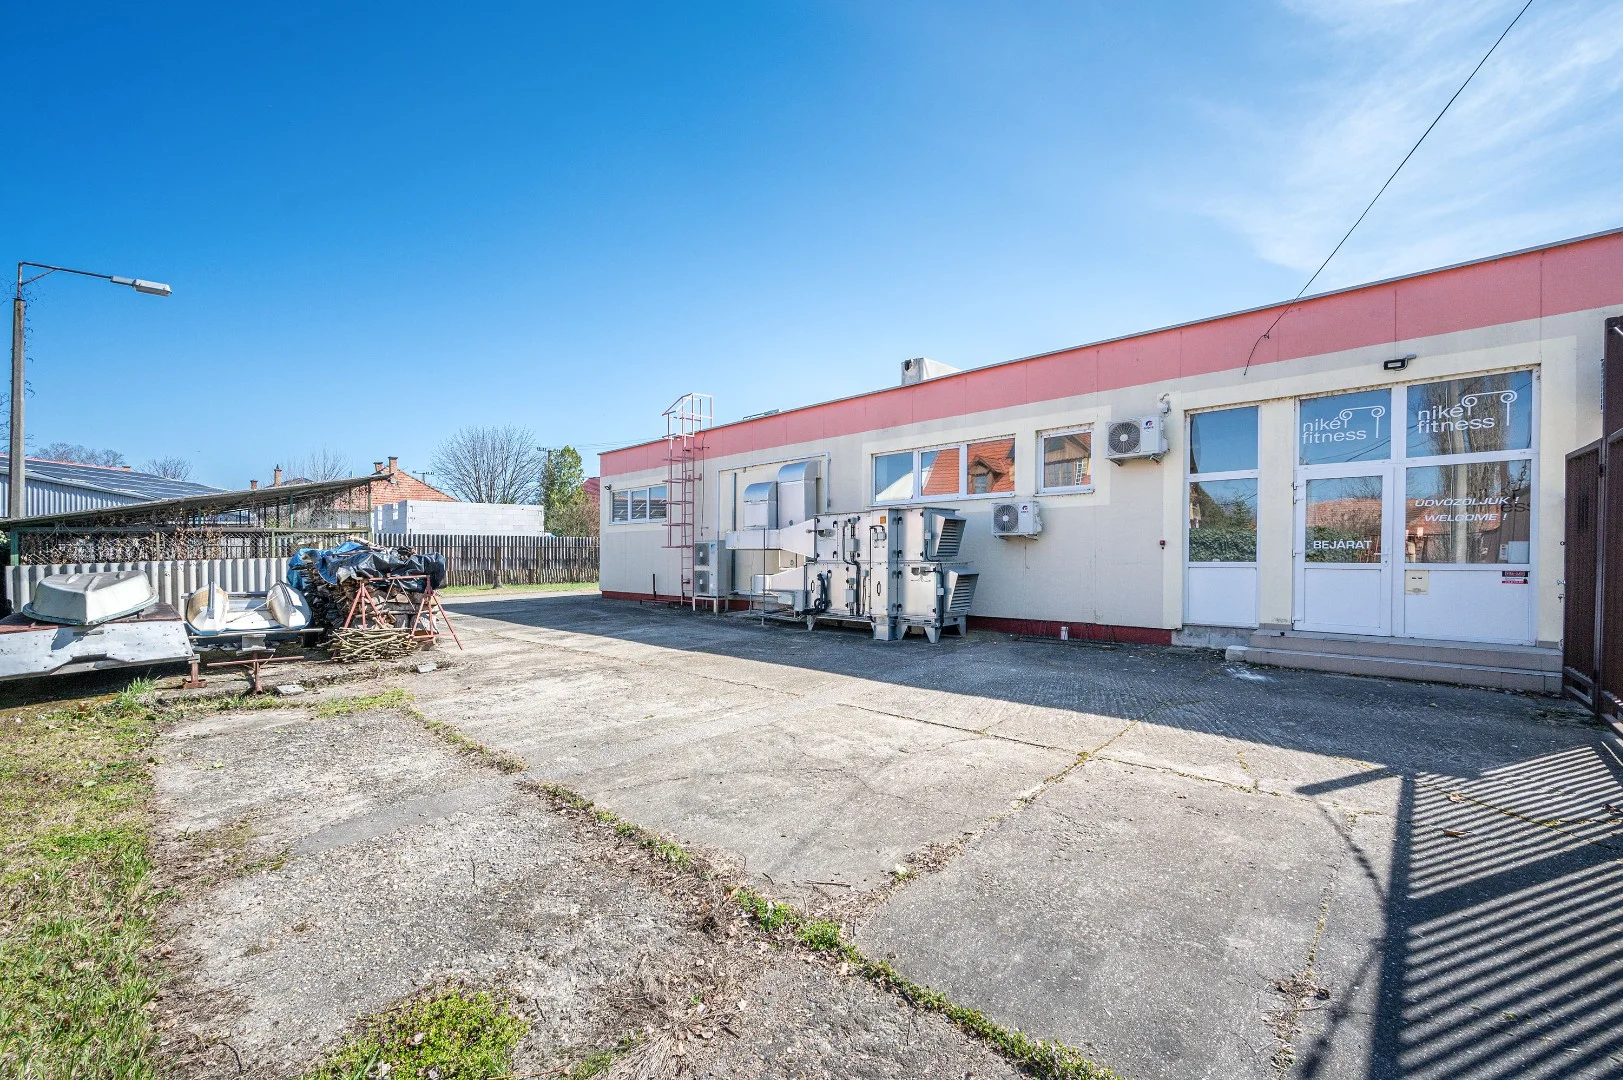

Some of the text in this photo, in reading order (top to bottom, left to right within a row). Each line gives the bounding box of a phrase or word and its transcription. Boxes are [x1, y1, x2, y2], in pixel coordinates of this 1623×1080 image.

[1418, 403, 1464, 420] niké
[1303, 416, 1341, 431] niké
[1417, 417, 1495, 433] fitness
[1302, 430, 1367, 444] fitness
[1424, 513, 1498, 522] WELCOME
[1313, 539, 1372, 551] BEJÁRAT
